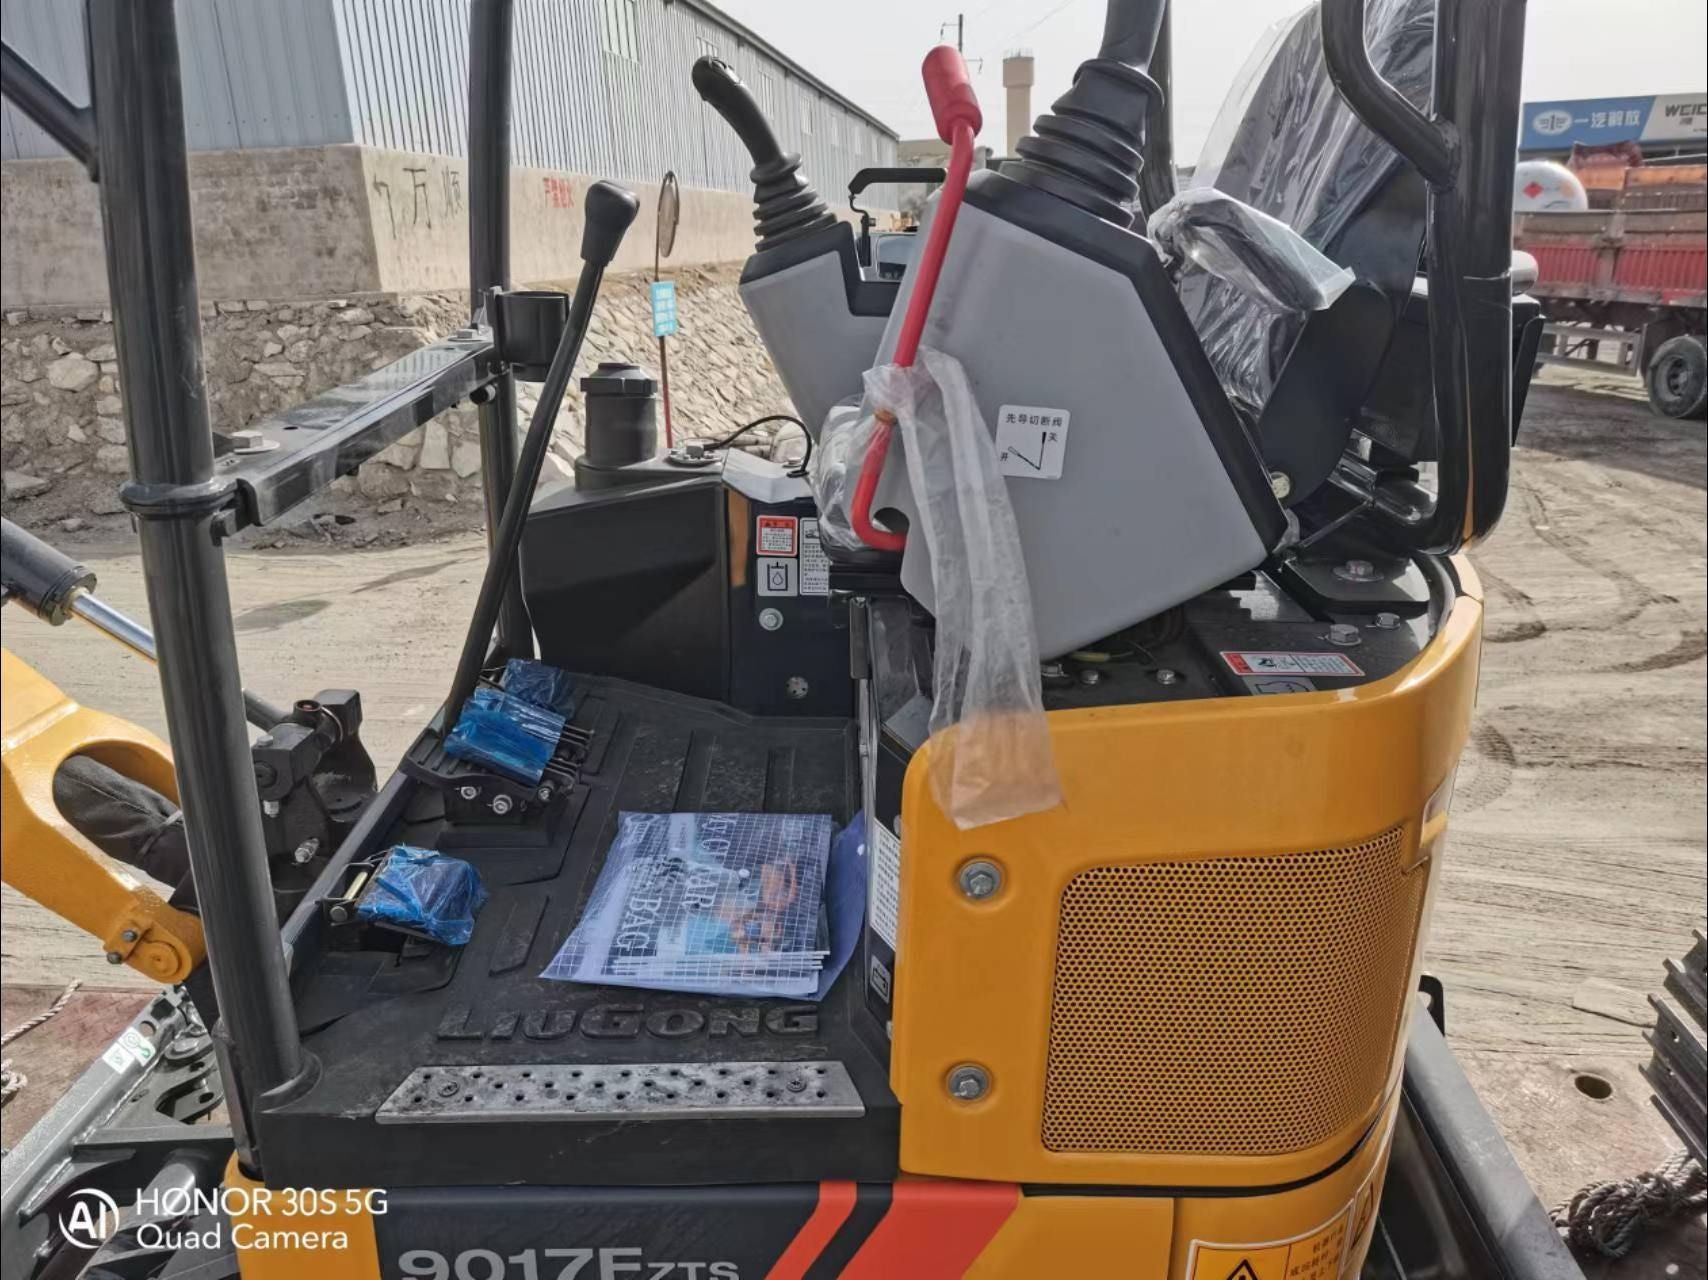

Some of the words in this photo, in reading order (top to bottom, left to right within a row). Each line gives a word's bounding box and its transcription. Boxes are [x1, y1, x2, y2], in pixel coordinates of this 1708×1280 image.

[1006, 413, 1062, 427] 先导切断阀
[615, 895, 662, 951] BAG
[436, 1003, 819, 1040] LIUGONG
